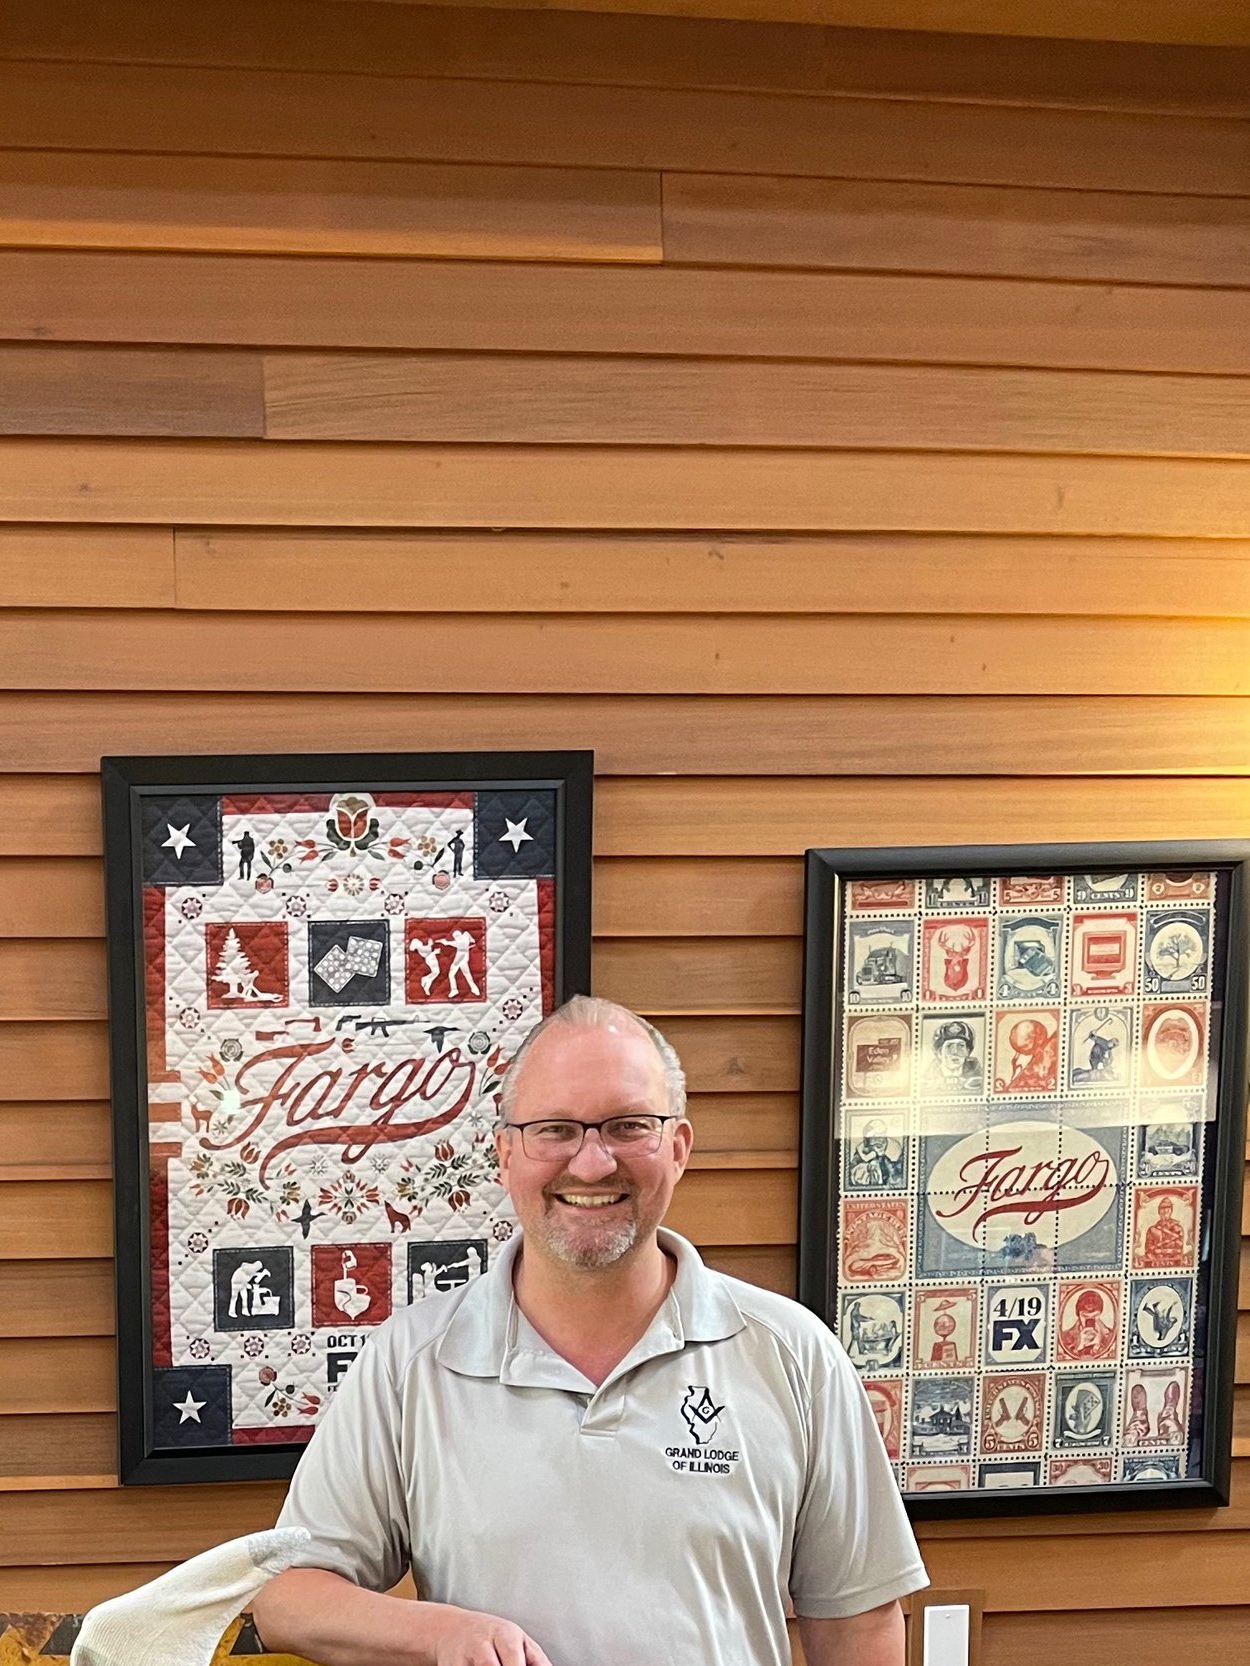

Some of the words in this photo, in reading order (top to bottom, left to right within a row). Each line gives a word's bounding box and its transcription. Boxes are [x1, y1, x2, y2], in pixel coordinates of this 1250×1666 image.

[1145, 978, 1159, 992] 50
[1191, 977, 1205, 990] 50
[868, 1047, 889, 1055] Eden
[199, 1038, 476, 1190] Fargo
[936, 1146, 1109, 1243] Fargo
[993, 1297, 1042, 1318] 4/19
[327, 1335, 357, 1348] OCT
[992, 1319, 1041, 1351] FX
[327, 1352, 358, 1383] F
[665, 1447, 701, 1458] GRAND
[704, 1449, 739, 1461] LODGE
[672, 1461, 686, 1471] OF
[689, 1462, 730, 1474] ILLINOIS
